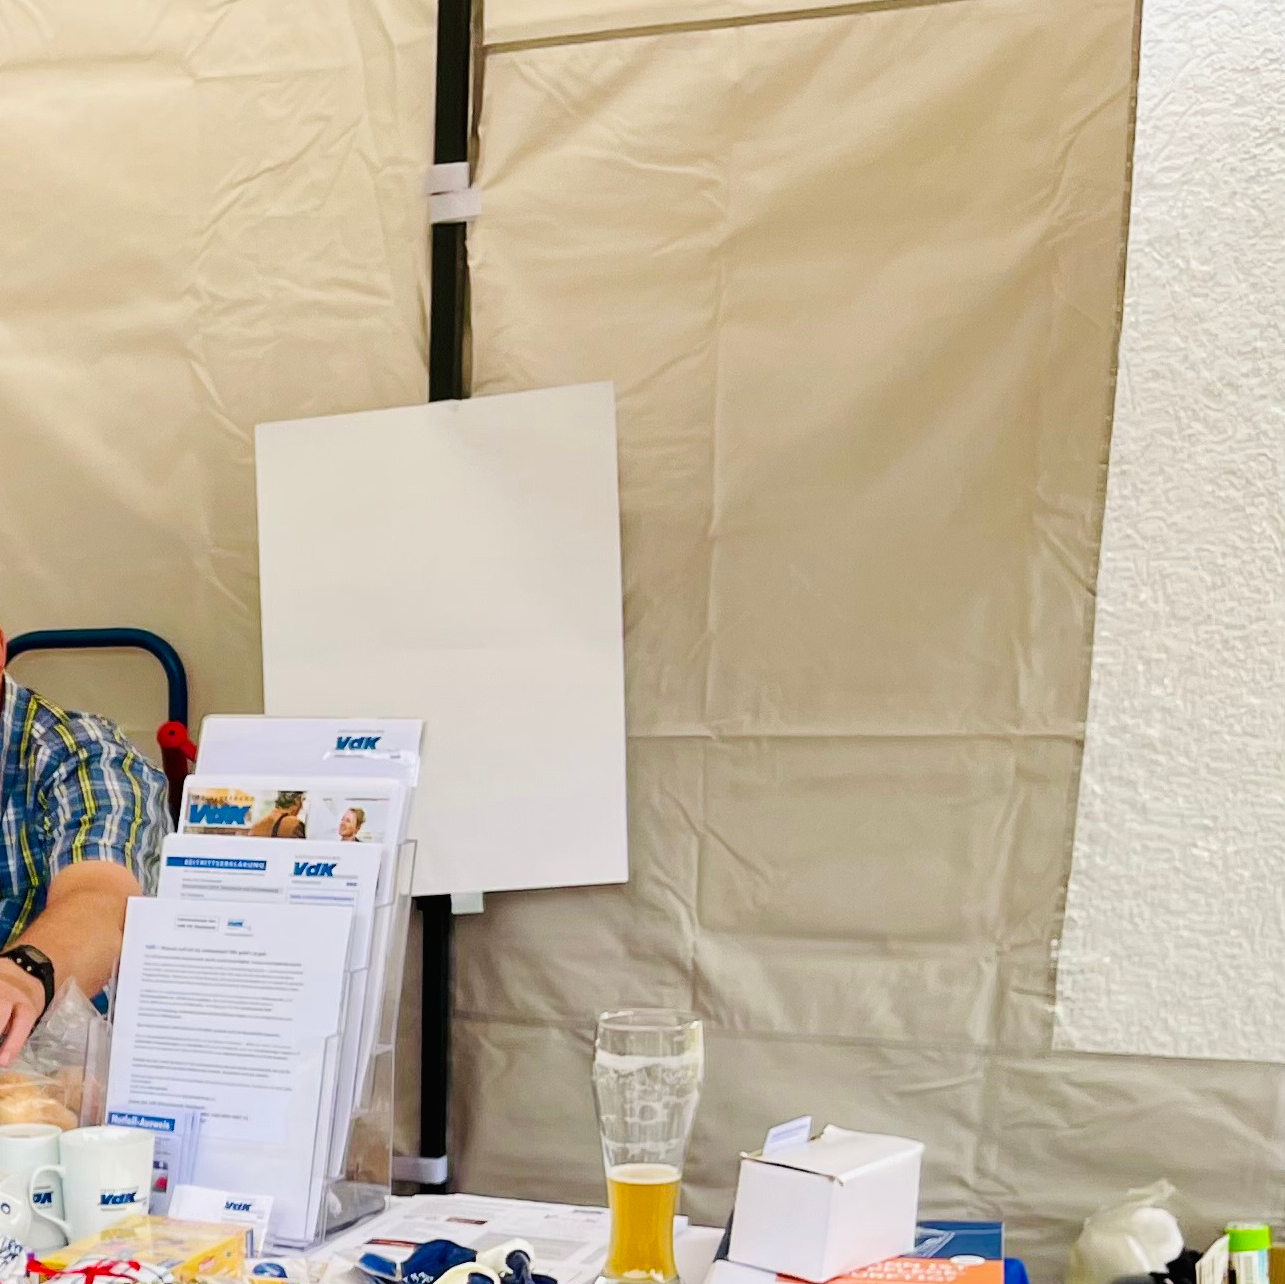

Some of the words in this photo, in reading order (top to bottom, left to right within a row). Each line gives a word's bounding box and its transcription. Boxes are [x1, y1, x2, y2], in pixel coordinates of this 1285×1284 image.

[335, 736, 383, 751] VdK
[188, 803, 251, 826] VdK
[293, 861, 339, 878] VdK
[99, 1191, 138, 1206] VdK
[224, 1200, 253, 1212] VdK
